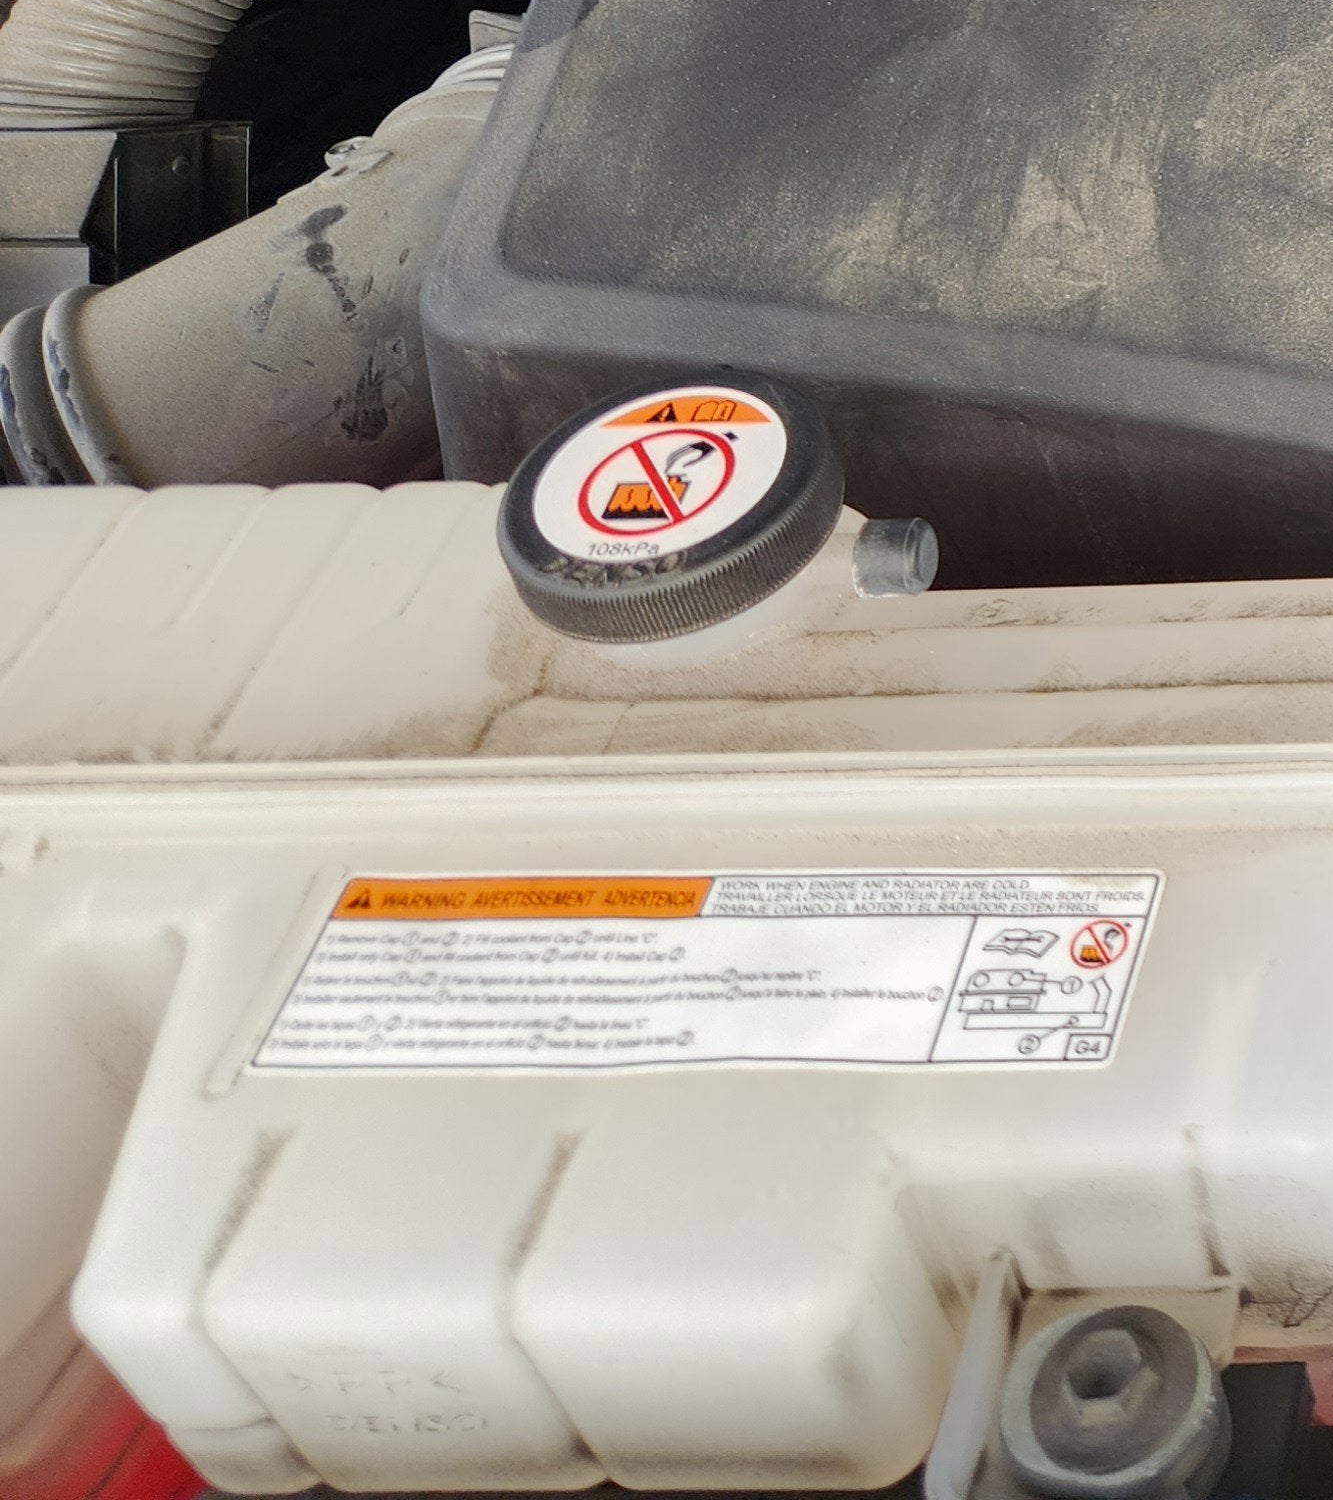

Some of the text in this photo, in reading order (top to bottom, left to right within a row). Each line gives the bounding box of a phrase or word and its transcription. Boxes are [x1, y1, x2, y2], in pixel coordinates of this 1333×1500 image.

[587, 542, 660, 556] 108kPa
[721, 879, 760, 891] WORK
[766, 879, 804, 891] WHEN
[809, 879, 858, 891] ENGINE
[862, 879, 890, 891] AND
[894, 879, 960, 891] RADIATOR
[963, 879, 988, 891] ARE
[381, 889, 696, 909] WARNING AVERTISSEMENT ADVERTENCIA
[717, 891, 792, 902] TRAVAILLER
[796, 891, 855, 902] LORSQUE
[861, 891, 878, 902] LE
[881, 891, 937, 902] MOTEUR
[942, 891, 957, 902] ET
[960, 891, 975, 902] LE
[980, 891, 1053, 902] RADIATEUR
[1056, 891, 1092, 902] SONT
[1075, 1041, 1101, 1055] G4
